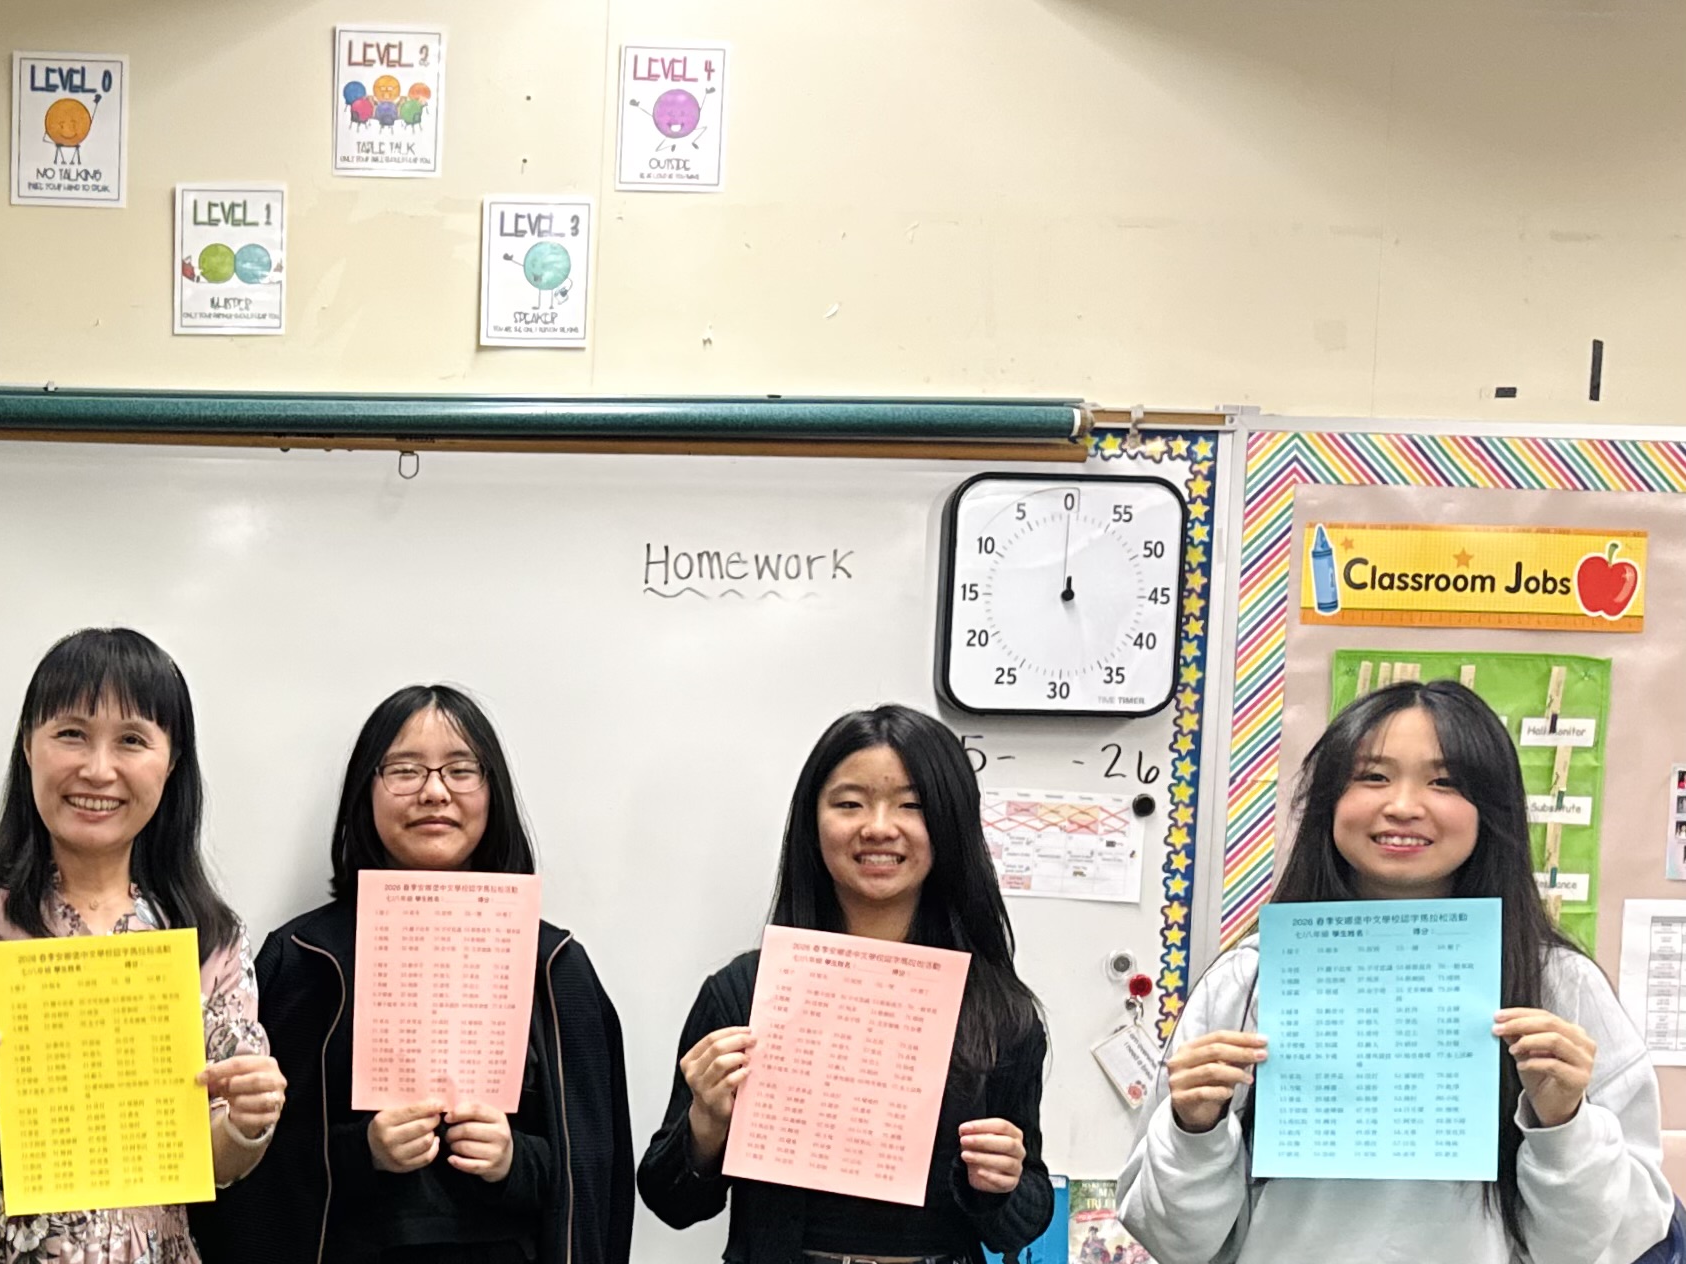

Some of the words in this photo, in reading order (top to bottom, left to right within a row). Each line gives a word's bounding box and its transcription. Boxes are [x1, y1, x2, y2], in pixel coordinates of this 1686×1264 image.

[348, 40, 414, 68] LEVEL
[419, 44, 430, 67] 2
[633, 54, 698, 82] LEVEL
[704, 60, 715, 81] 4
[30, 64, 97, 93] LEVEL
[102, 69, 113, 93] 0
[649, 157, 691, 171] OUTSIDE
[36, 168, 56, 180] NO
[59, 168, 102, 182] TALKING
[193, 199, 259, 227] LEVEL
[264, 203, 272, 226] 1
[500, 210, 565, 238] LEVEL
[570, 214, 580, 237] 3
[1064, 493, 1075, 511] 0
[1016, 503, 1027, 520] 5
[1112, 505, 1133, 523] 55
[977, 536, 995, 554] 10
[1143, 541, 1165, 558] 50
[644, 543, 855, 585] Homework
[1343, 557, 1495, 593] Classroom
[1504, 561, 1571, 595] Jobs
[960, 583, 979, 601] 15
[1148, 587, 1171, 605] 45
[966, 629, 989, 647] 20
[1133, 632, 1156, 650] 40
[994, 667, 1017, 685] 25
[1103, 666, 1125, 684] 35
[1046, 681, 1070, 699] 30
[1098, 695, 1115, 704] TIME
[1118, 696, 1145, 705] TIMER
[1552, 726, 1587, 737] onitor
[1292, 917, 1314, 927] 2026
